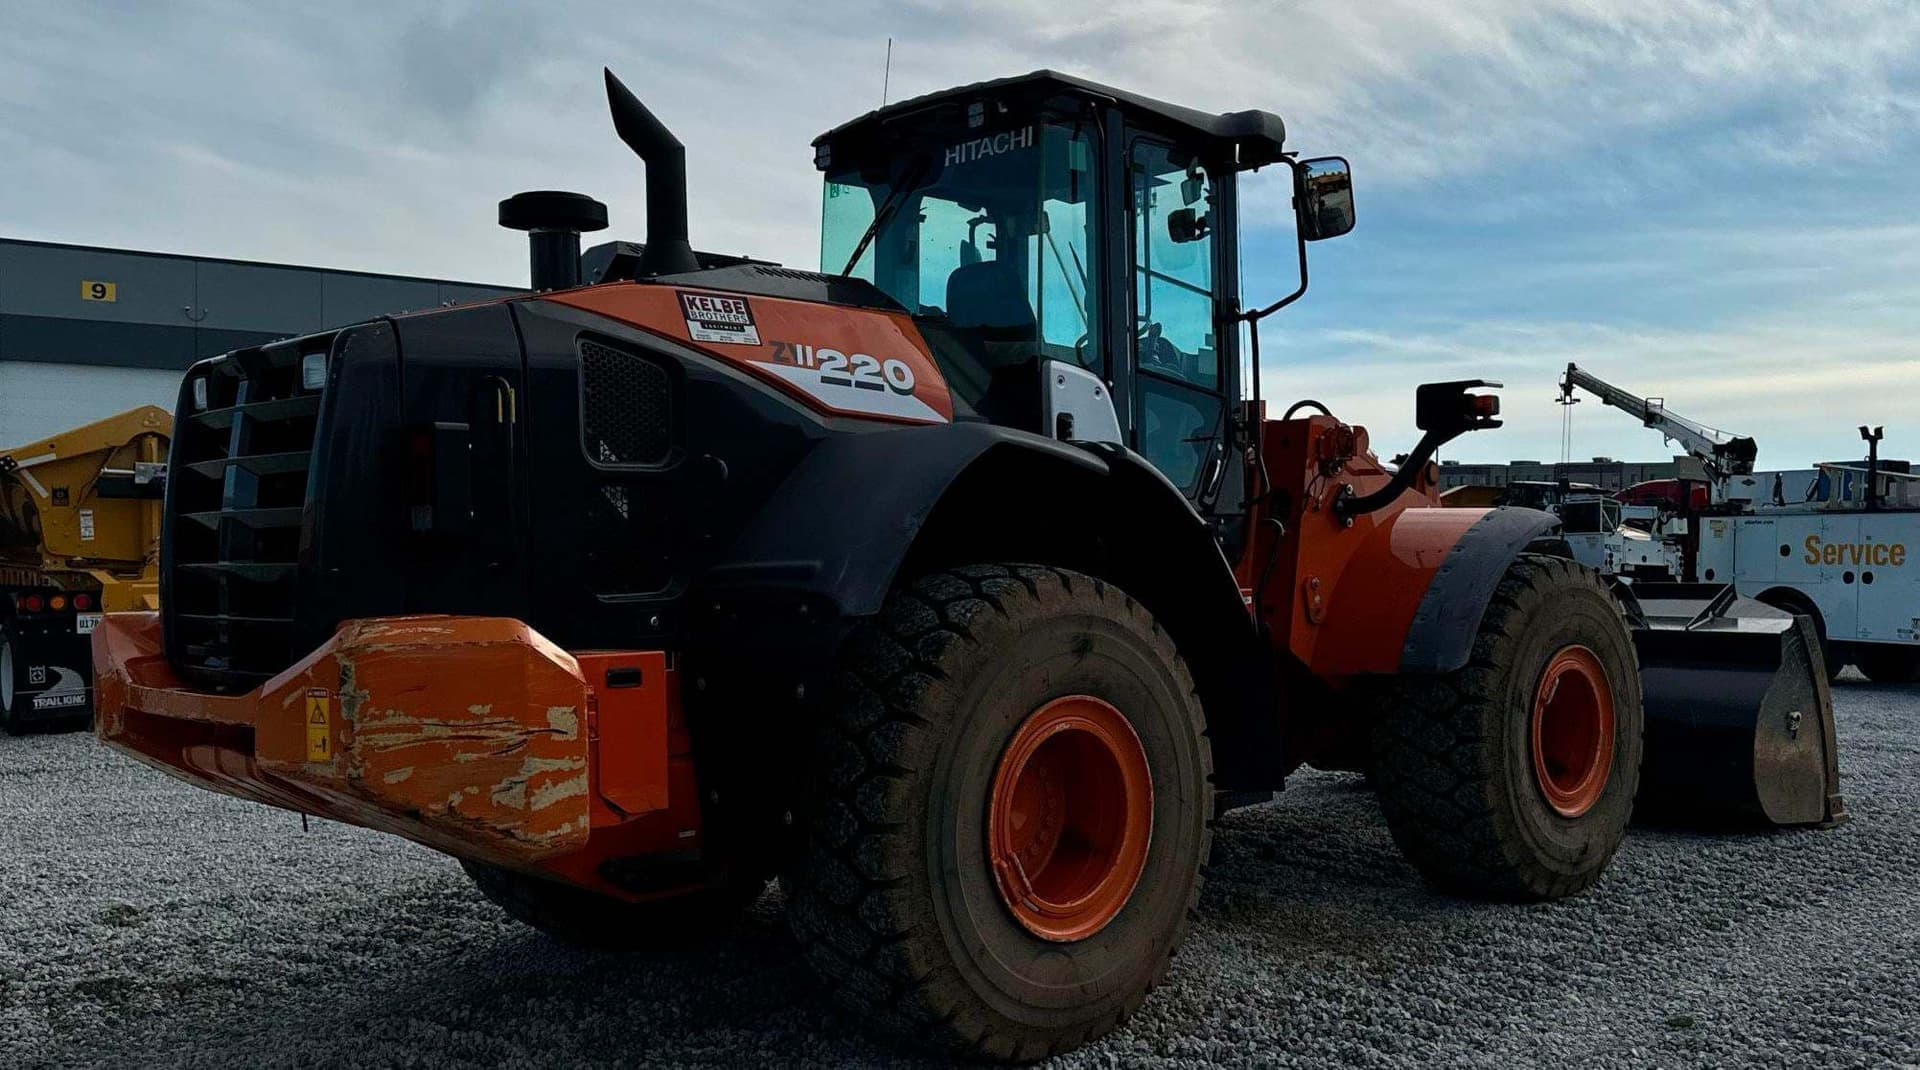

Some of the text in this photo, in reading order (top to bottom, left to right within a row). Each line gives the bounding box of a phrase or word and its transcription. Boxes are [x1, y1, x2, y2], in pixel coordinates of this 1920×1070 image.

[944, 125, 1033, 167] HITACHI
[91, 283, 107, 300] 9
[686, 296, 745, 314] KELBE
[690, 311, 747, 323] BROTHERS
[1804, 535, 1906, 566] Service
